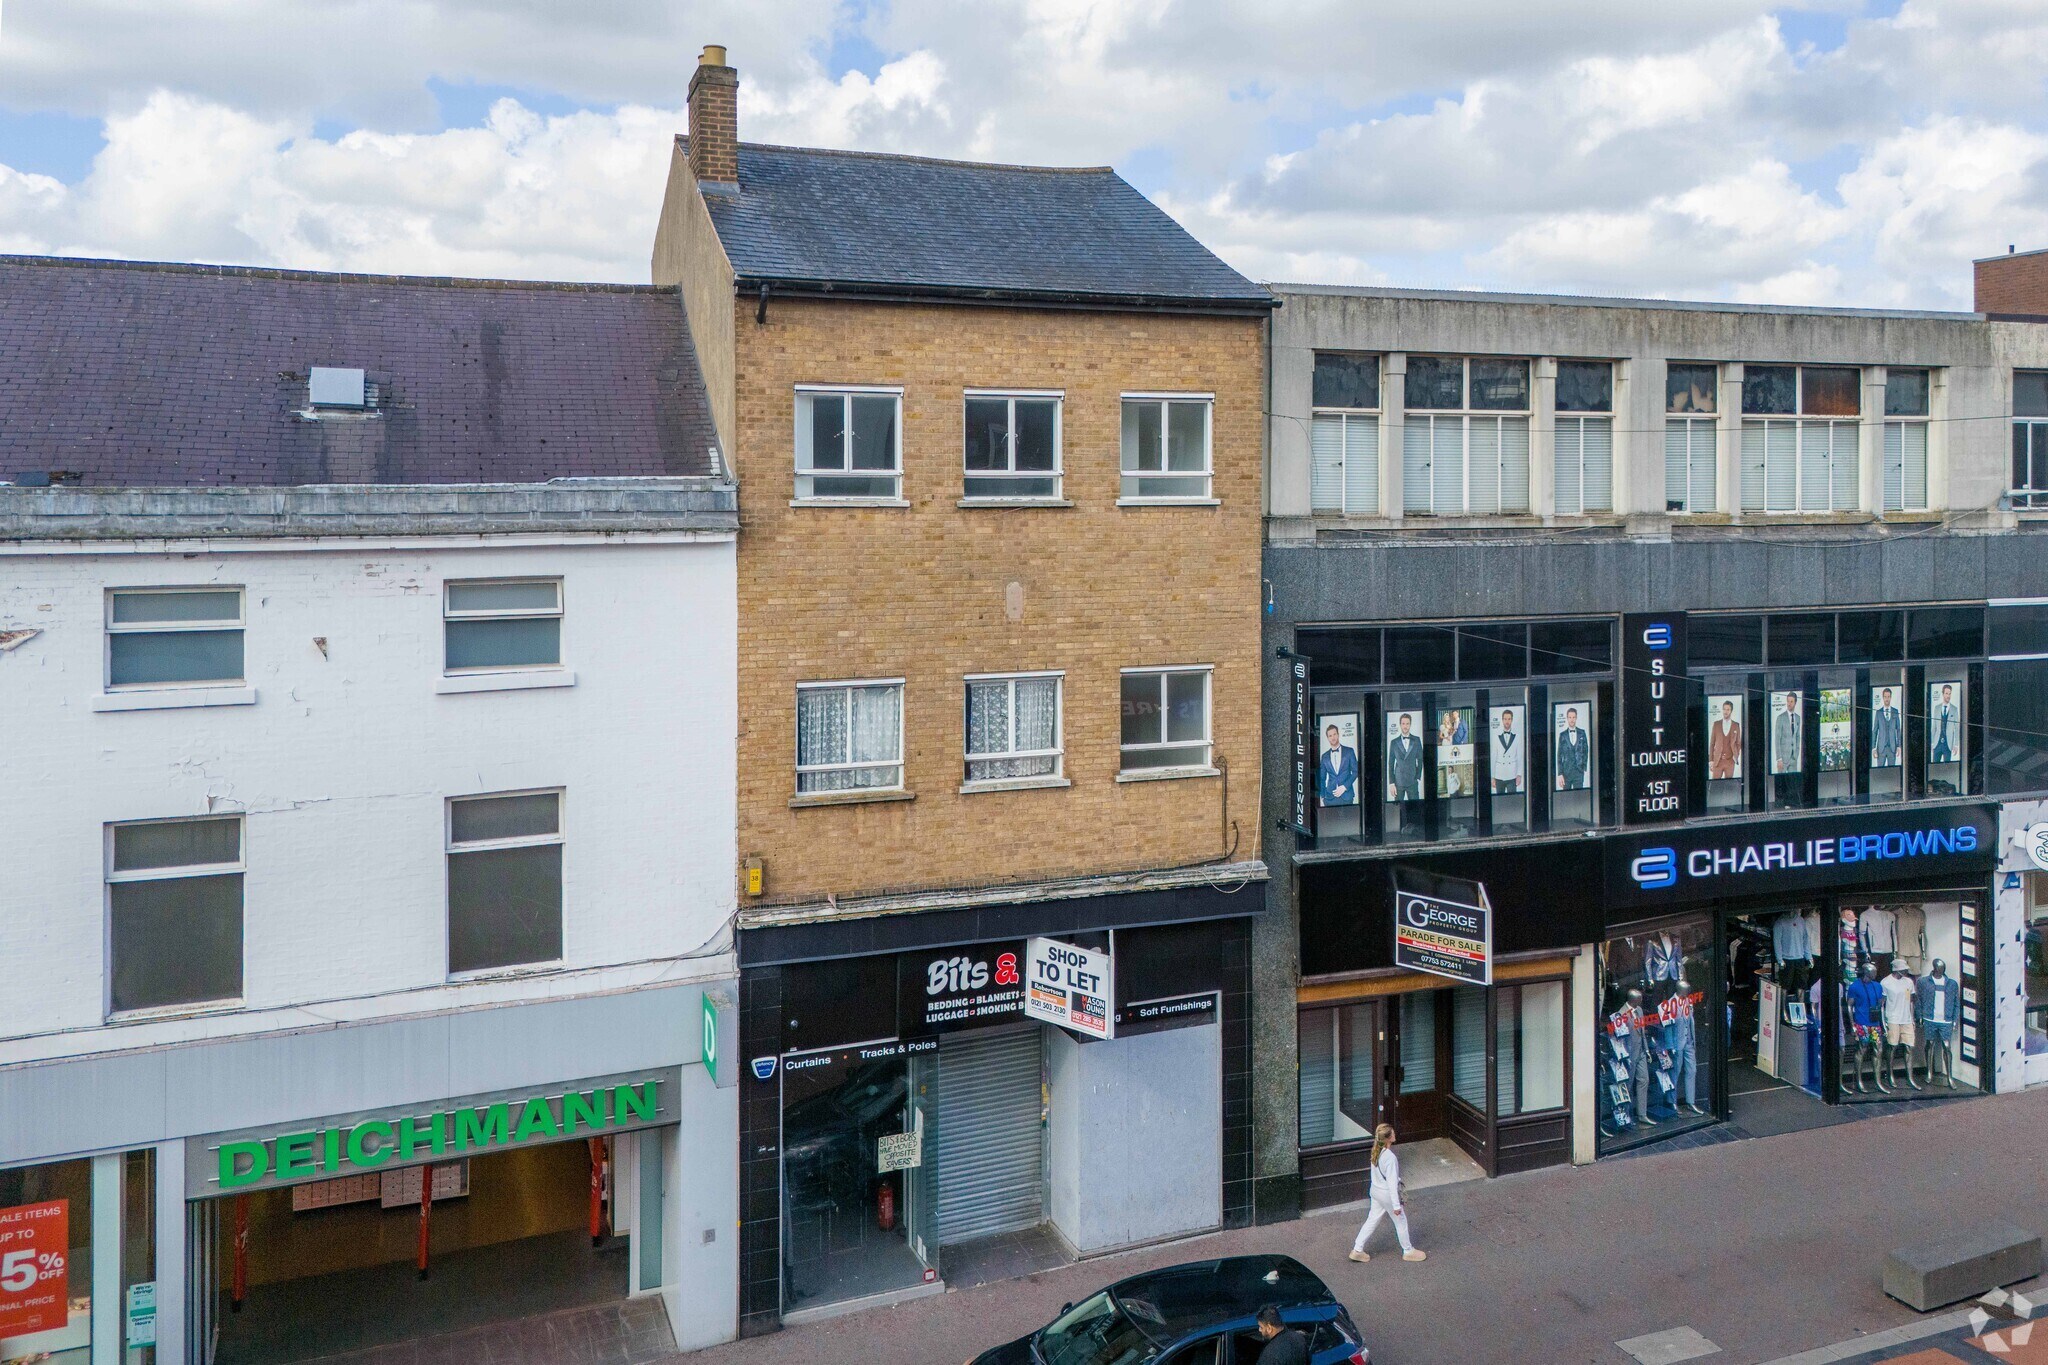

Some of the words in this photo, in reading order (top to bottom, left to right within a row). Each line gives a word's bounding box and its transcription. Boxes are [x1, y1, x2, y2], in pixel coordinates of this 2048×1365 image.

[1631, 750, 1686, 766] LOUNGE
[1647, 781, 1670, 795] 1ST
[1639, 797, 1679, 812] FLOOR
[1688, 838, 1834, 877] CHARLIE
[1839, 826, 1977, 863] BROWNS
[1407, 899, 1477, 929] GEORGE
[1429, 920, 1456, 930] PROPERTY
[1458, 925, 1477, 934] GROUP
[1401, 928, 1435, 943] PARADE
[1437, 939, 1455, 947] FOR
[1458, 941, 1482, 952] SALE
[1048, 946, 1087, 968] SHOP
[1412, 941, 1436, 950] Business
[1447, 948, 1470, 957] Affected
[1420, 955, 1440, 965] 07753
[1440, 959, 1462, 970] 572411
[926, 956, 989, 995] Bits
[995, 952, 1019, 985] &
[1036, 959, 1060, 982] TO
[1067, 968, 1100, 993] LET
[1034, 982, 1063, 997] Robertson
[928, 998, 968, 1011] BEDDING
[976, 990, 1019, 1004] BLANKETS
[1081, 995, 1105, 1008] MASON
[1140, 1008, 1159, 1017] Soft
[1160, 999, 1212, 1014] Furnishings
[926, 1009, 969, 1022] LUGGAGE
[976, 1002, 1016, 1016] SMOKING
[1081, 1002, 1105, 1016] YOUNG
[1607, 1009, 1632, 1035] MOST
[1689, 992, 1703, 1005] OFF
[785, 1056, 831, 1070] Curtains
[860, 1048, 895, 1059] Tracks
[898, 1044, 906, 1054] &
[908, 1039, 937, 1052] Poles
[218, 1078, 657, 1188] DEICHMANN
[880, 1136, 894, 1147] BITS
[894, 1141, 917, 1151] MOVED
[884, 1149, 916, 1160] OPPOSITE
[0, 1212, 22, 1223] ALE
[25, 1206, 61, 1219] ITEMS
[16, 1229, 35, 1239] TO
[38, 1268, 64, 1281] OFF
[24, 1294, 55, 1307] PRICE
